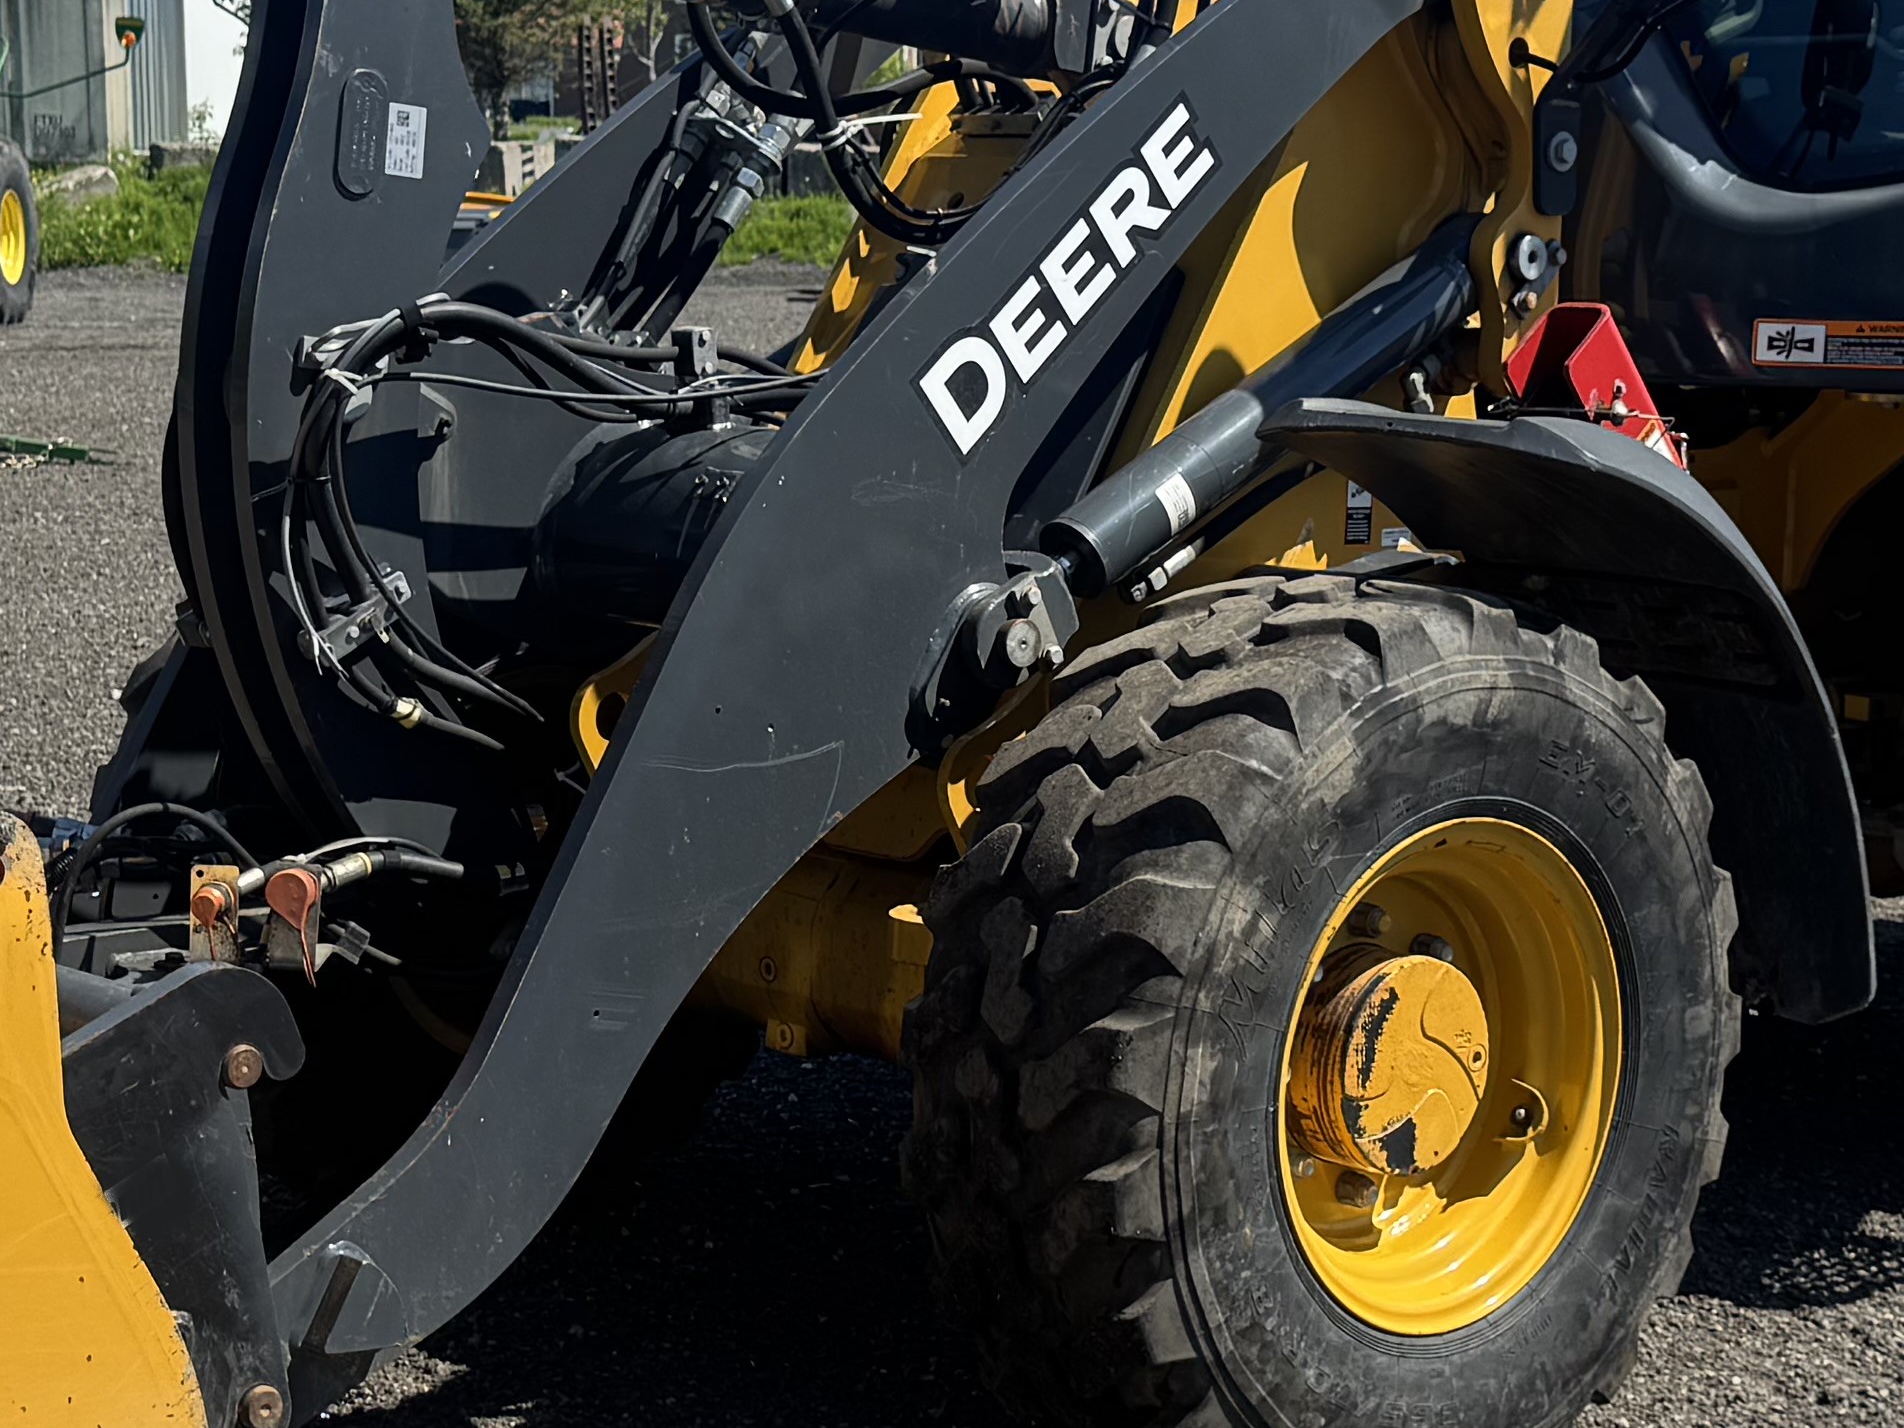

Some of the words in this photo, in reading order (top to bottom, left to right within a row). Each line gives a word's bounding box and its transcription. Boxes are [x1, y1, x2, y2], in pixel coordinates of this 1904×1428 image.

[920, 104, 1214, 454] DEERE
[1537, 729, 1644, 847] EM-01
[1601, 1124, 1682, 1298] RADIAL
